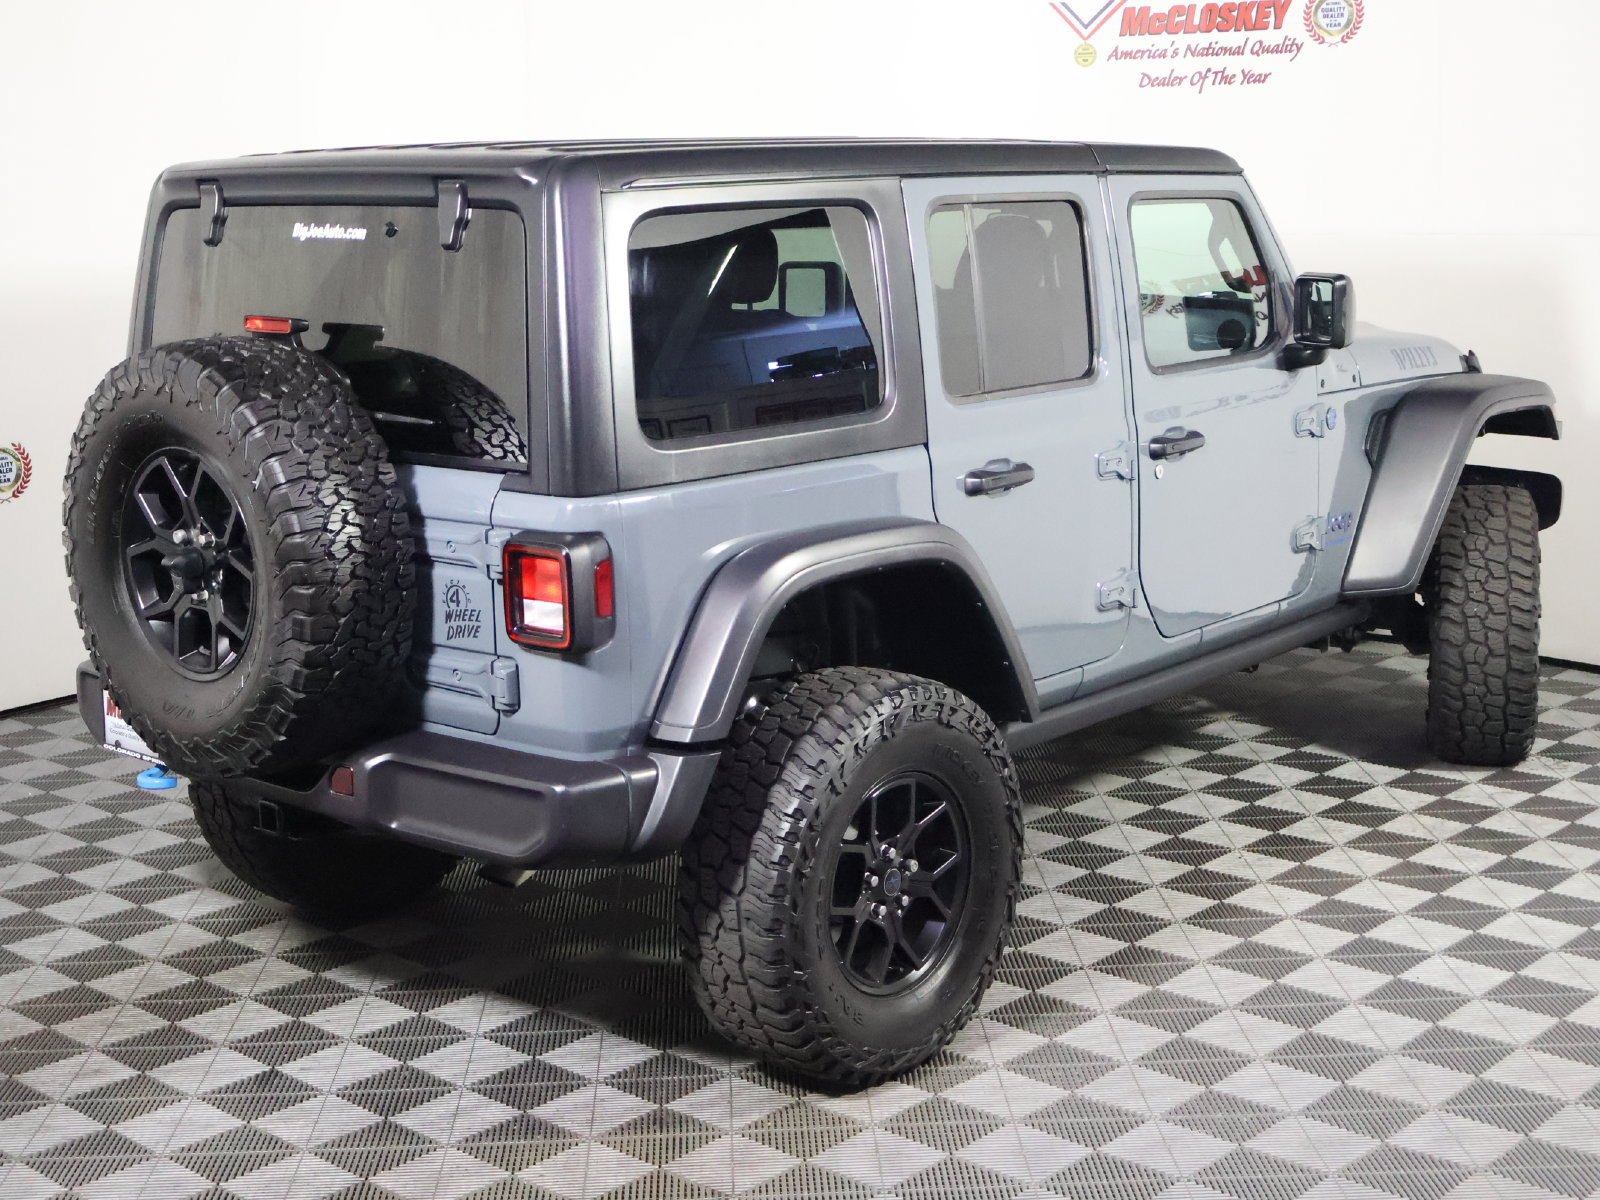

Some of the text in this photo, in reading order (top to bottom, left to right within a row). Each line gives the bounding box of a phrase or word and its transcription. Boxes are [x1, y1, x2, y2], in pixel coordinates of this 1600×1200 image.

[1119, 0, 1293, 37] McCLOSKEY
[1107, 41, 1180, 62] America's
[1183, 38, 1246, 59] National
[1250, 36, 1304, 62] Quality
[1138, 67, 1272, 94] Dealer Of The Year
[449, 588, 461, 608] 4
[445, 609, 482, 625] WHEEL
[446, 624, 481, 641] DRIVE
[103, 743, 142, 759] COLORADO
